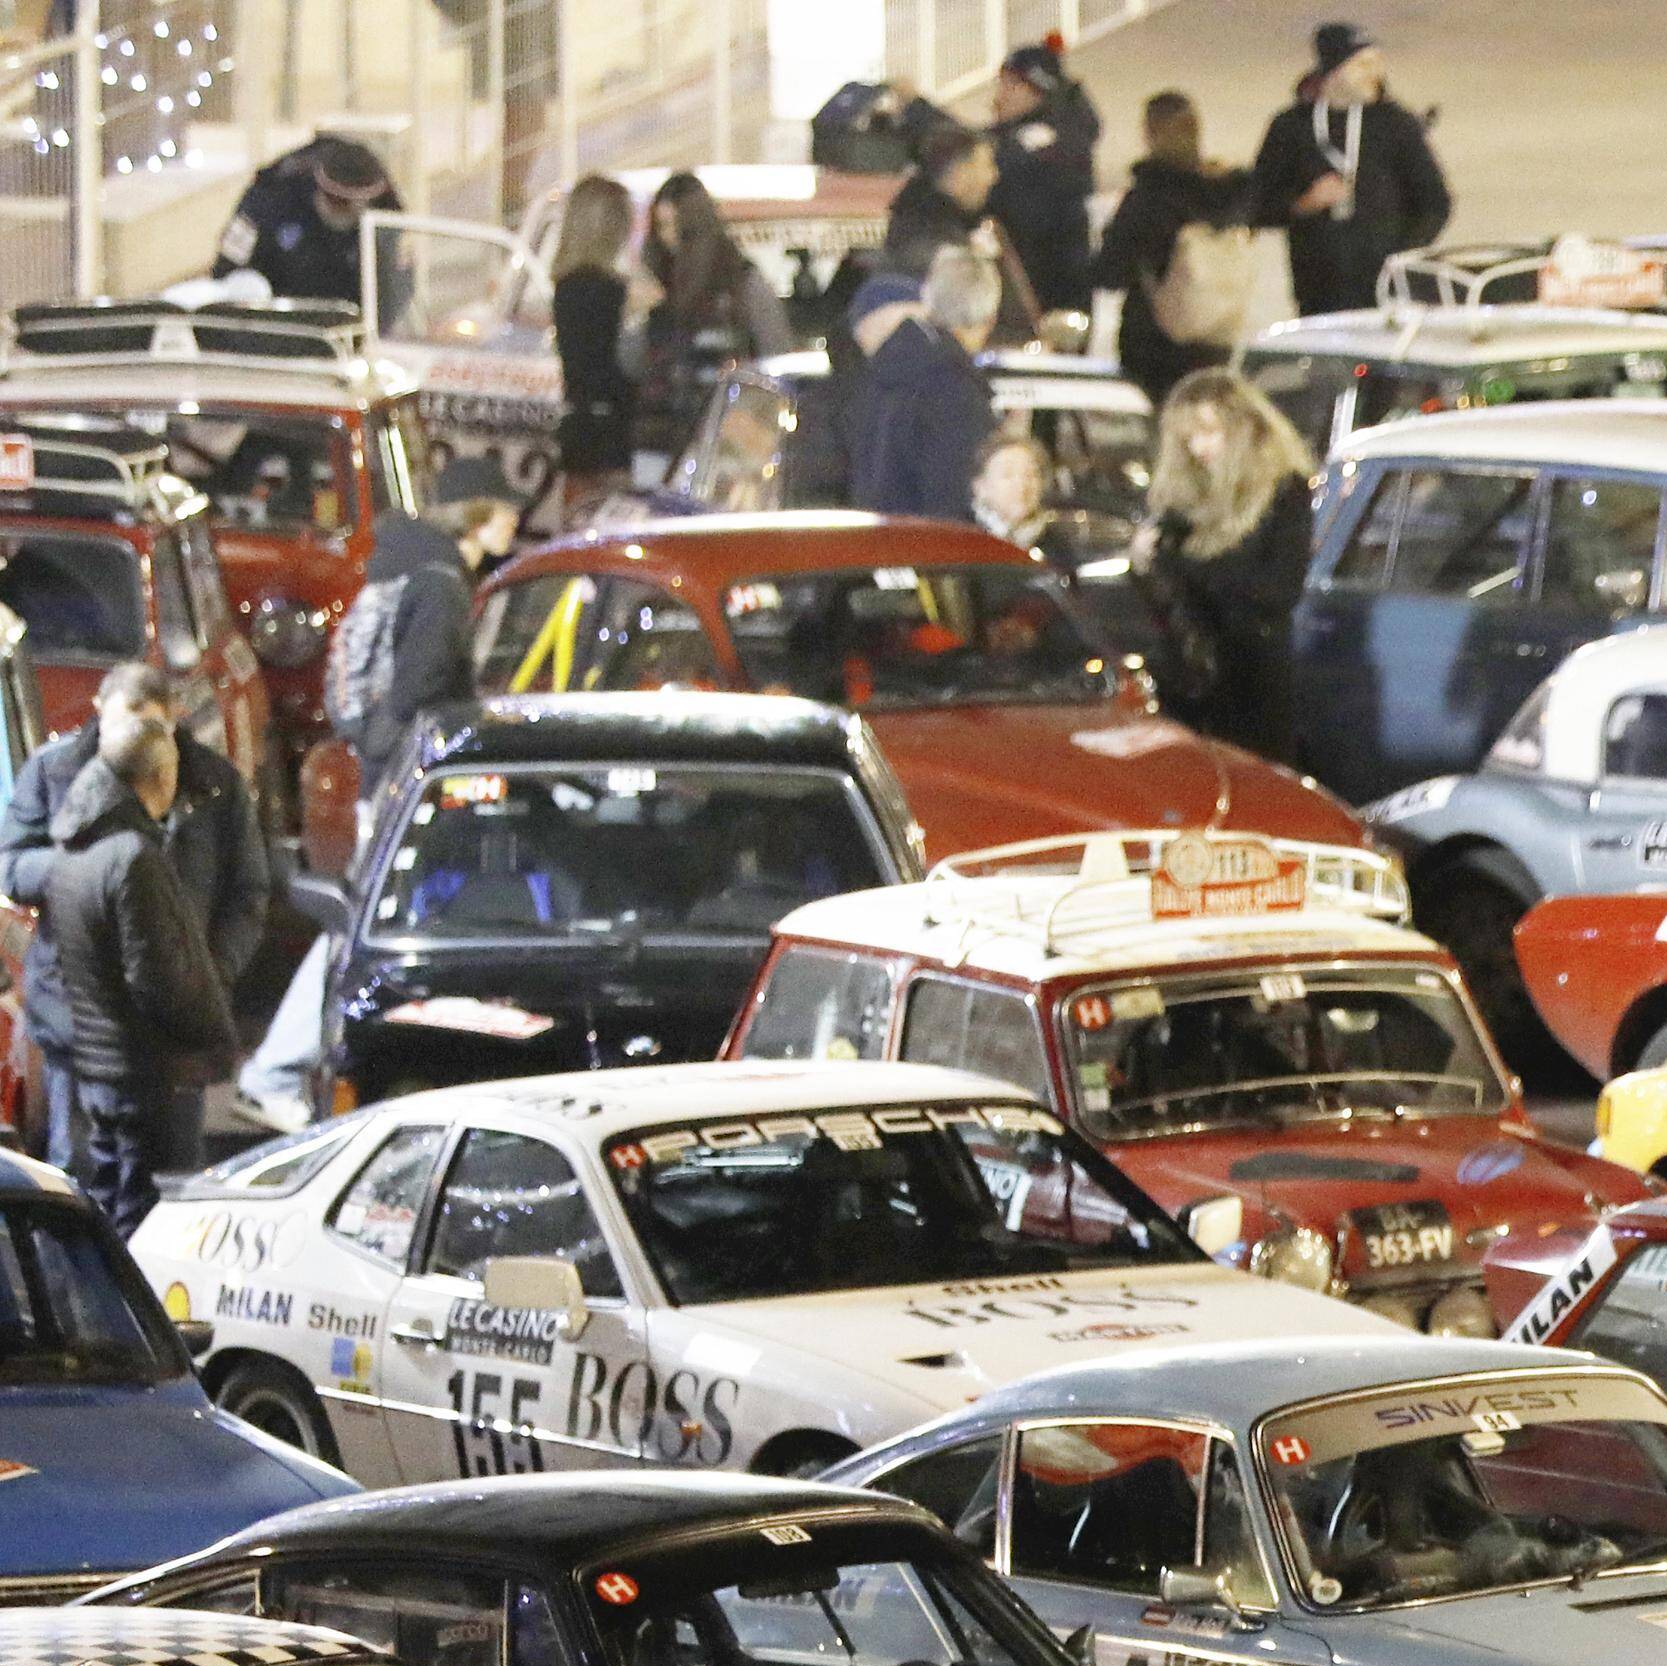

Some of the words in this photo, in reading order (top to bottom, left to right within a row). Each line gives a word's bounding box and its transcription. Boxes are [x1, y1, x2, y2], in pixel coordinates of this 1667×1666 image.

[1080, 997, 1108, 1025] H
[643, 1098, 1066, 1162] PORSCHE
[216, 1284, 292, 1326] MILAN
[307, 1303, 378, 1339] Shell
[474, 1302, 560, 1343] CASINO
[1510, 1258, 1596, 1345] ILAN
[447, 1369, 545, 1480] 155
[566, 1352, 740, 1466] BOSS
[1375, 1386, 1580, 1430] SINVEST
[1483, 1413, 1506, 1429] 94
[1275, 1438, 1306, 1463] H
[599, 1573, 635, 1602] H
